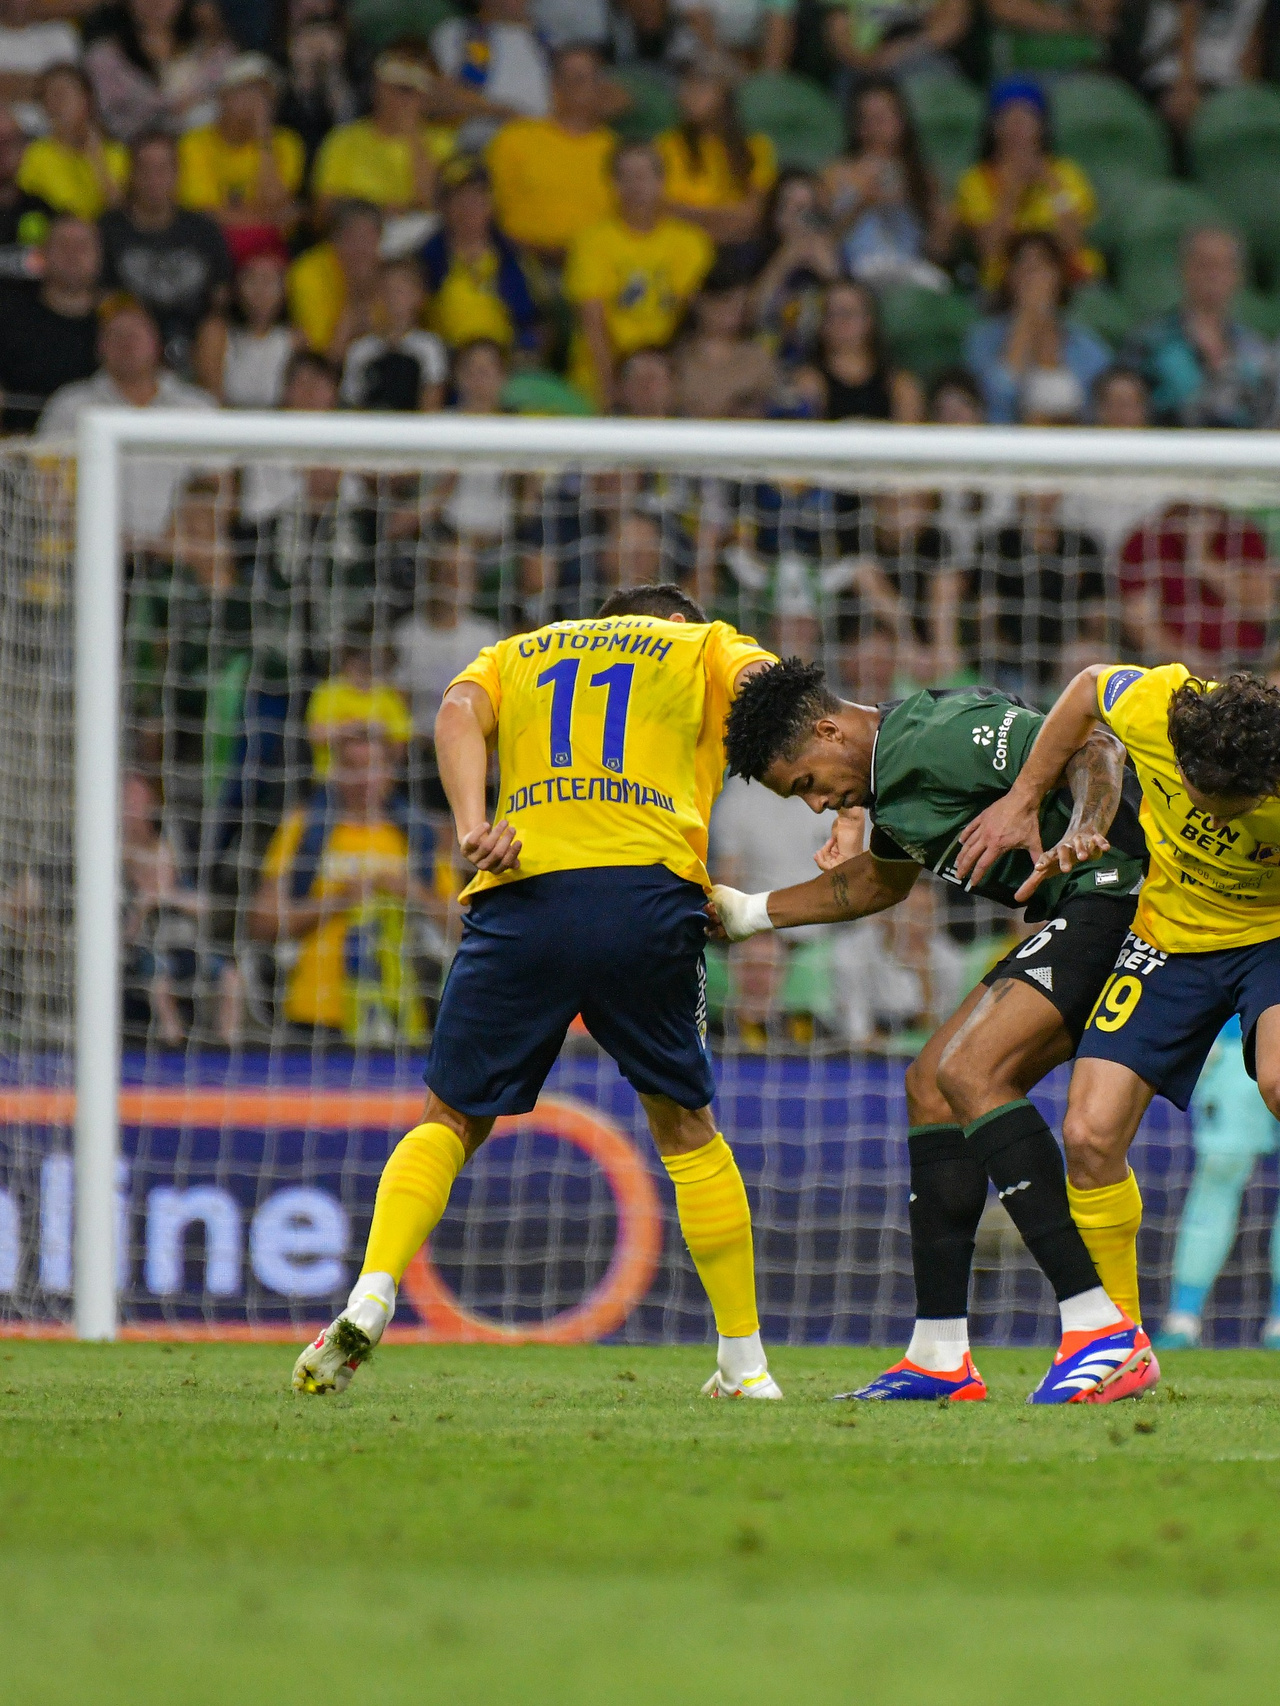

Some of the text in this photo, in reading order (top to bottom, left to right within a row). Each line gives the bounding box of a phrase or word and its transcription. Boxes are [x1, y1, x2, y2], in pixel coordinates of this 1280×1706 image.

[518, 632, 674, 662] СУТОРМИН
[536, 658, 636, 775] 11
[992, 710, 1019, 771] Constell
[1179, 823, 1233, 857] BET
[1184, 806, 1241, 844] FON
[1016, 917, 1068, 959] 6
[1114, 949, 1167, 976] BET
[1084, 972, 1143, 1033] 19
